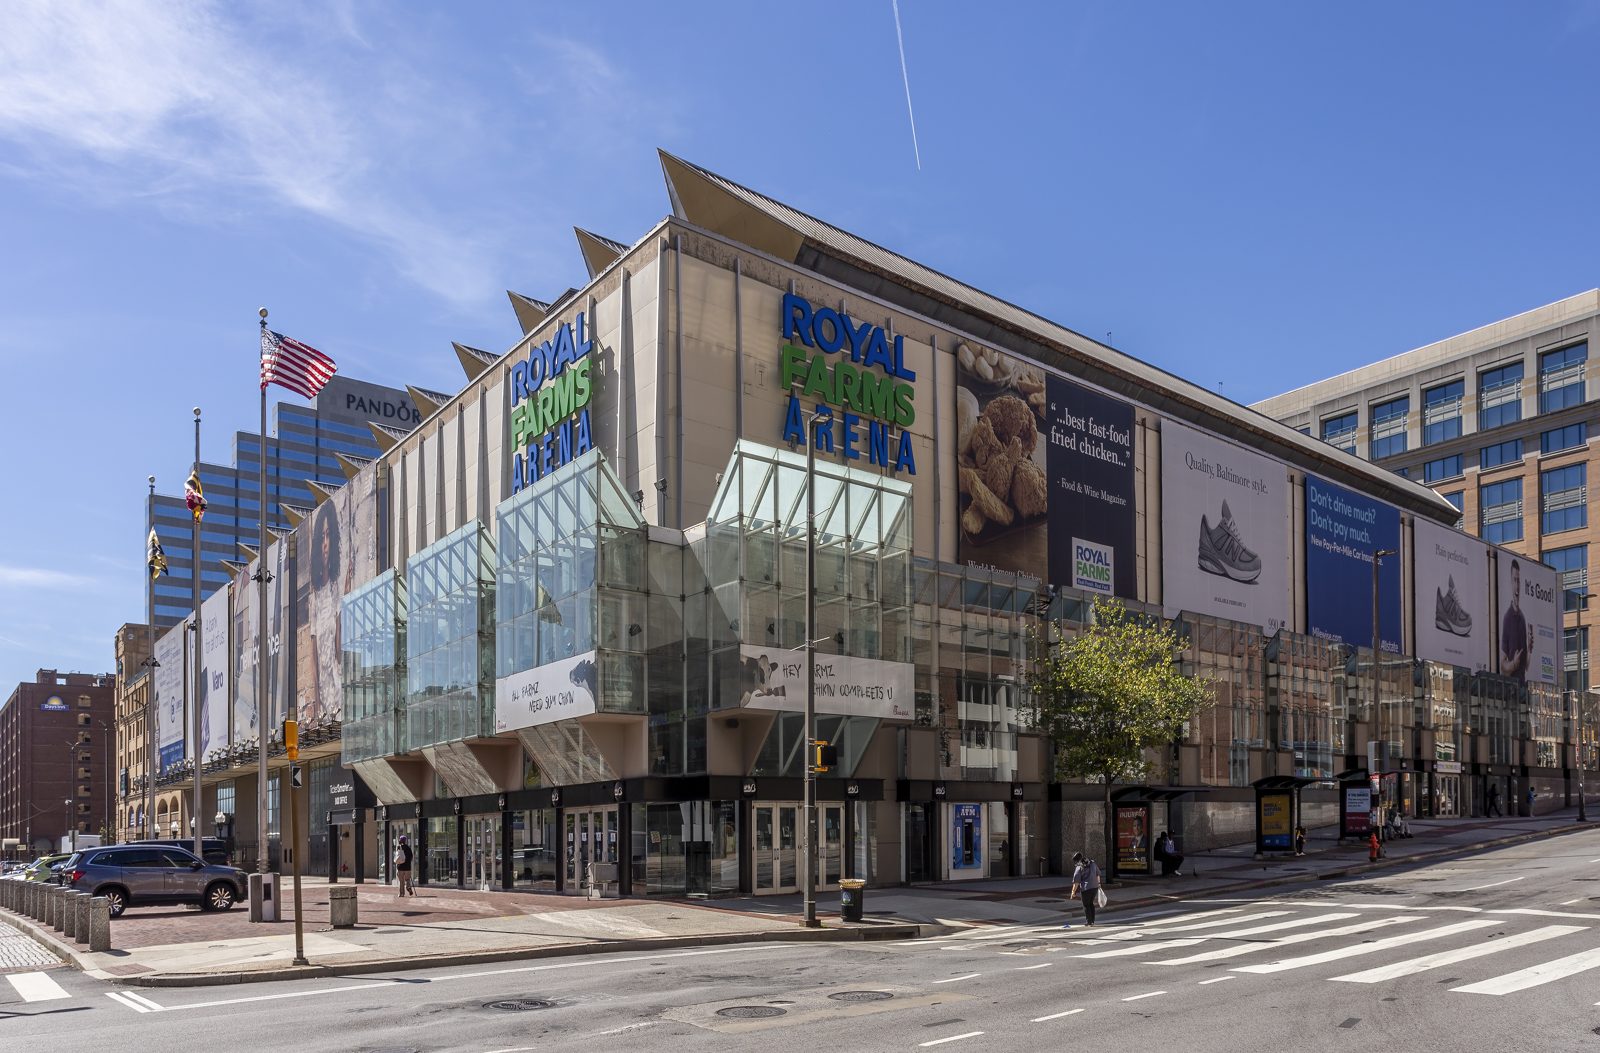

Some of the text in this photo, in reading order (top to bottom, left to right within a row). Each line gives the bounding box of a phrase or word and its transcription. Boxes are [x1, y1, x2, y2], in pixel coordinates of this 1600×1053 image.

[782, 292, 916, 382] ROYAL
[511, 311, 593, 408] ROYAL
[781, 344, 916, 427] FARMS
[346, 394, 420, 424] PANDOR
[511, 358, 592, 453] FARMS
[783, 395, 916, 476] ARENA
[1050, 425, 1077, 451] fried
[1088, 417, 1130, 447] fast-food
[512, 408, 592, 496] ARENA
[1216, 463, 1251, 489] Baltimore
[1061, 477, 1076, 492] Food
[1076, 483, 1083, 493] &
[1083, 484, 1100, 499] Wine
[1101, 489, 1127, 506] Magazine
[1310, 486, 1377, 525] Don't drive much?
[1311, 508, 1372, 545] Don't pay much.
[1076, 545, 1110, 567] ROYAL
[1311, 534, 1323, 548] New
[1322, 538, 1353, 559] Pay-Per-Mile
[1352, 548, 1362, 560] Car
[1076, 561, 1111, 582] FARMS
[1524, 579, 1554, 603] It's Good!
[783, 664, 836, 680] HEY RMZ
[528, 698, 544, 714] NEED
[839, 684, 885, 700] COMPLEETS
[887, 686, 893, 700] U
[960, 808, 976, 816] ATM
